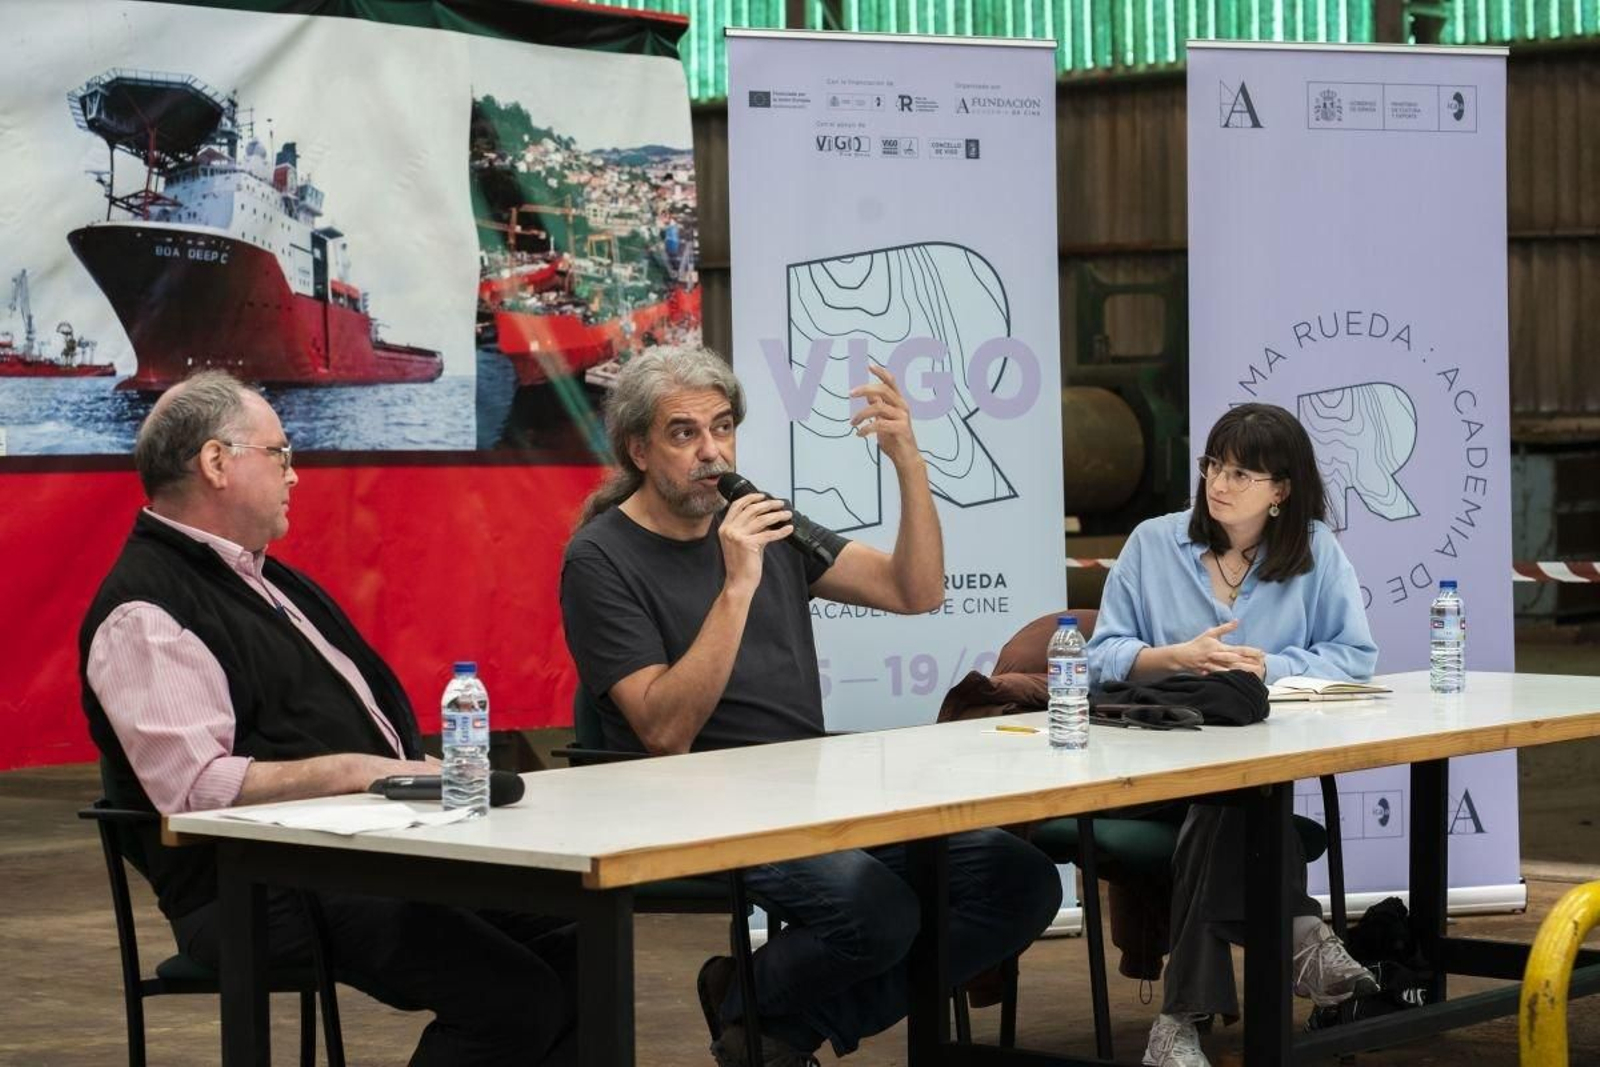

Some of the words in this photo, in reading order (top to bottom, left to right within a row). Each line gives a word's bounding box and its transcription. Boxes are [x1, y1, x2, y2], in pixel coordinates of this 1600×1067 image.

[971, 96, 1041, 109] FUNDACIÓN
[1293, 311, 1412, 351] RUEDA
[758, 336, 1041, 421] VIGO
[1434, 367, 1488, 558] ACADEMIA
[1386, 563, 1433, 604] DE
[962, 596, 1009, 614] CINE
